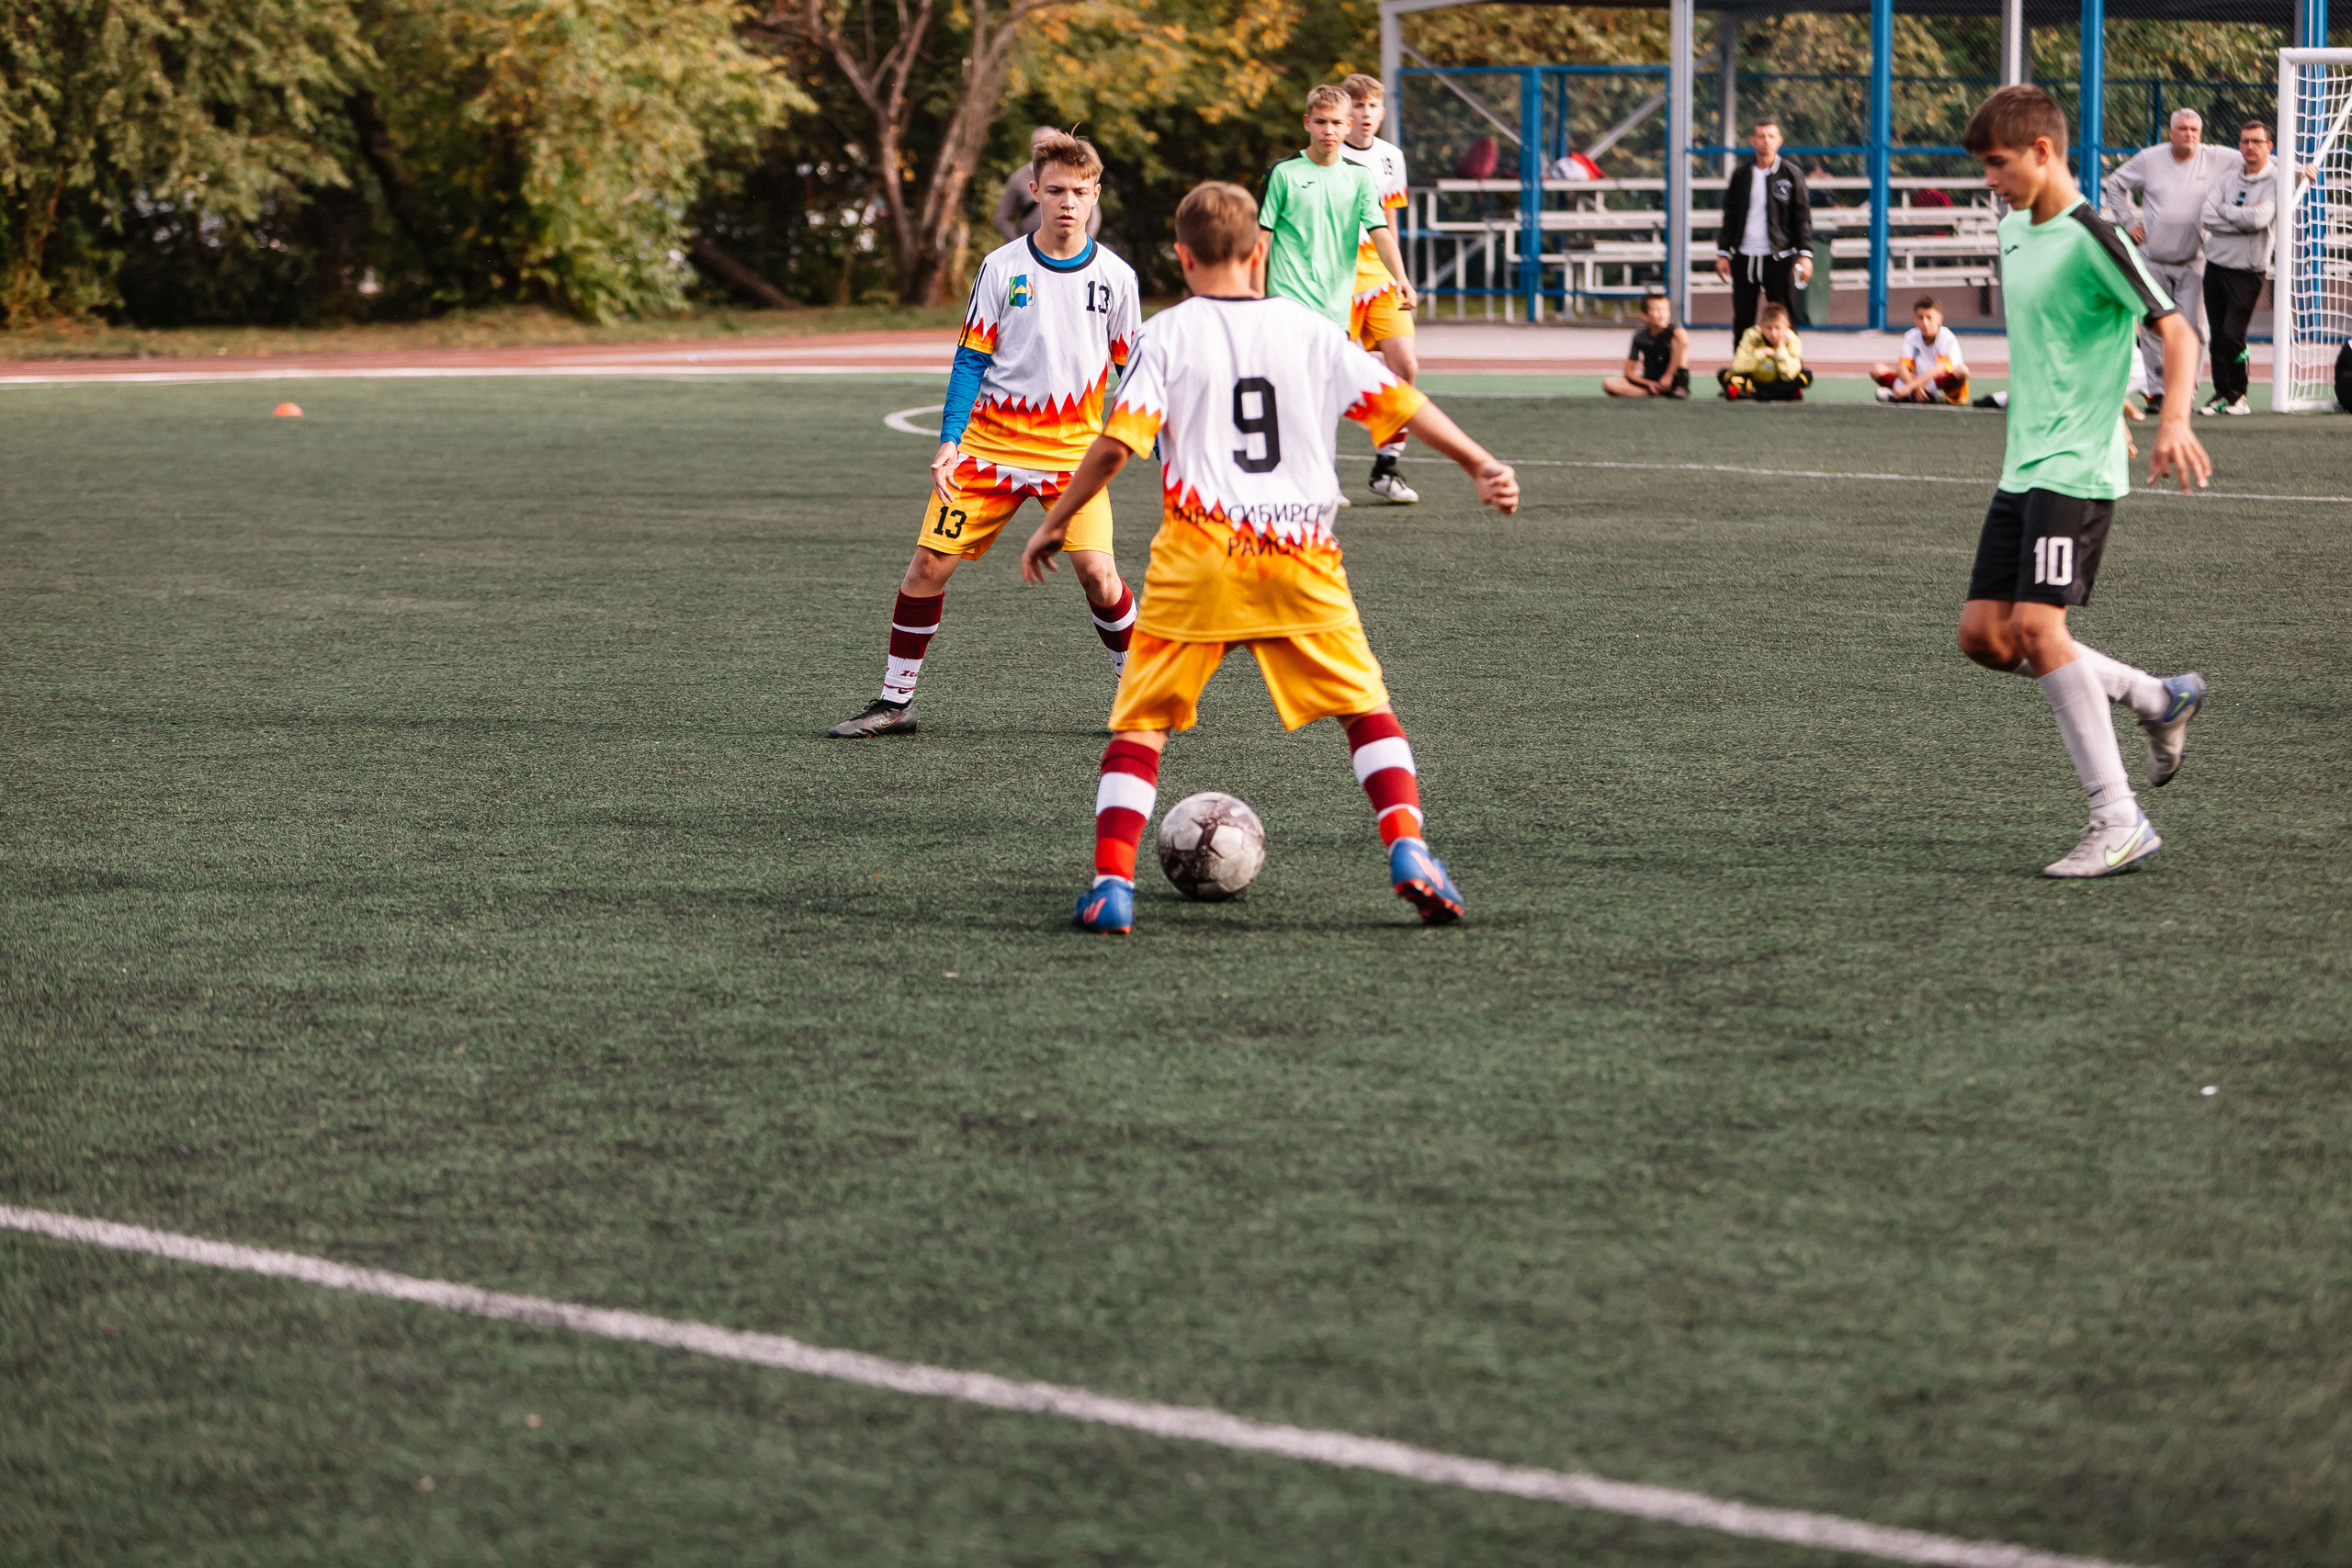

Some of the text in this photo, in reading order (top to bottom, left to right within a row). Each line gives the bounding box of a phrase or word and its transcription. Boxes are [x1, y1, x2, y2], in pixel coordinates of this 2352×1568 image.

[1086, 280, 1110, 314] 13
[1233, 377, 1282, 474] 9
[933, 505, 967, 539] 13
[2033, 536, 2074, 586] 10
